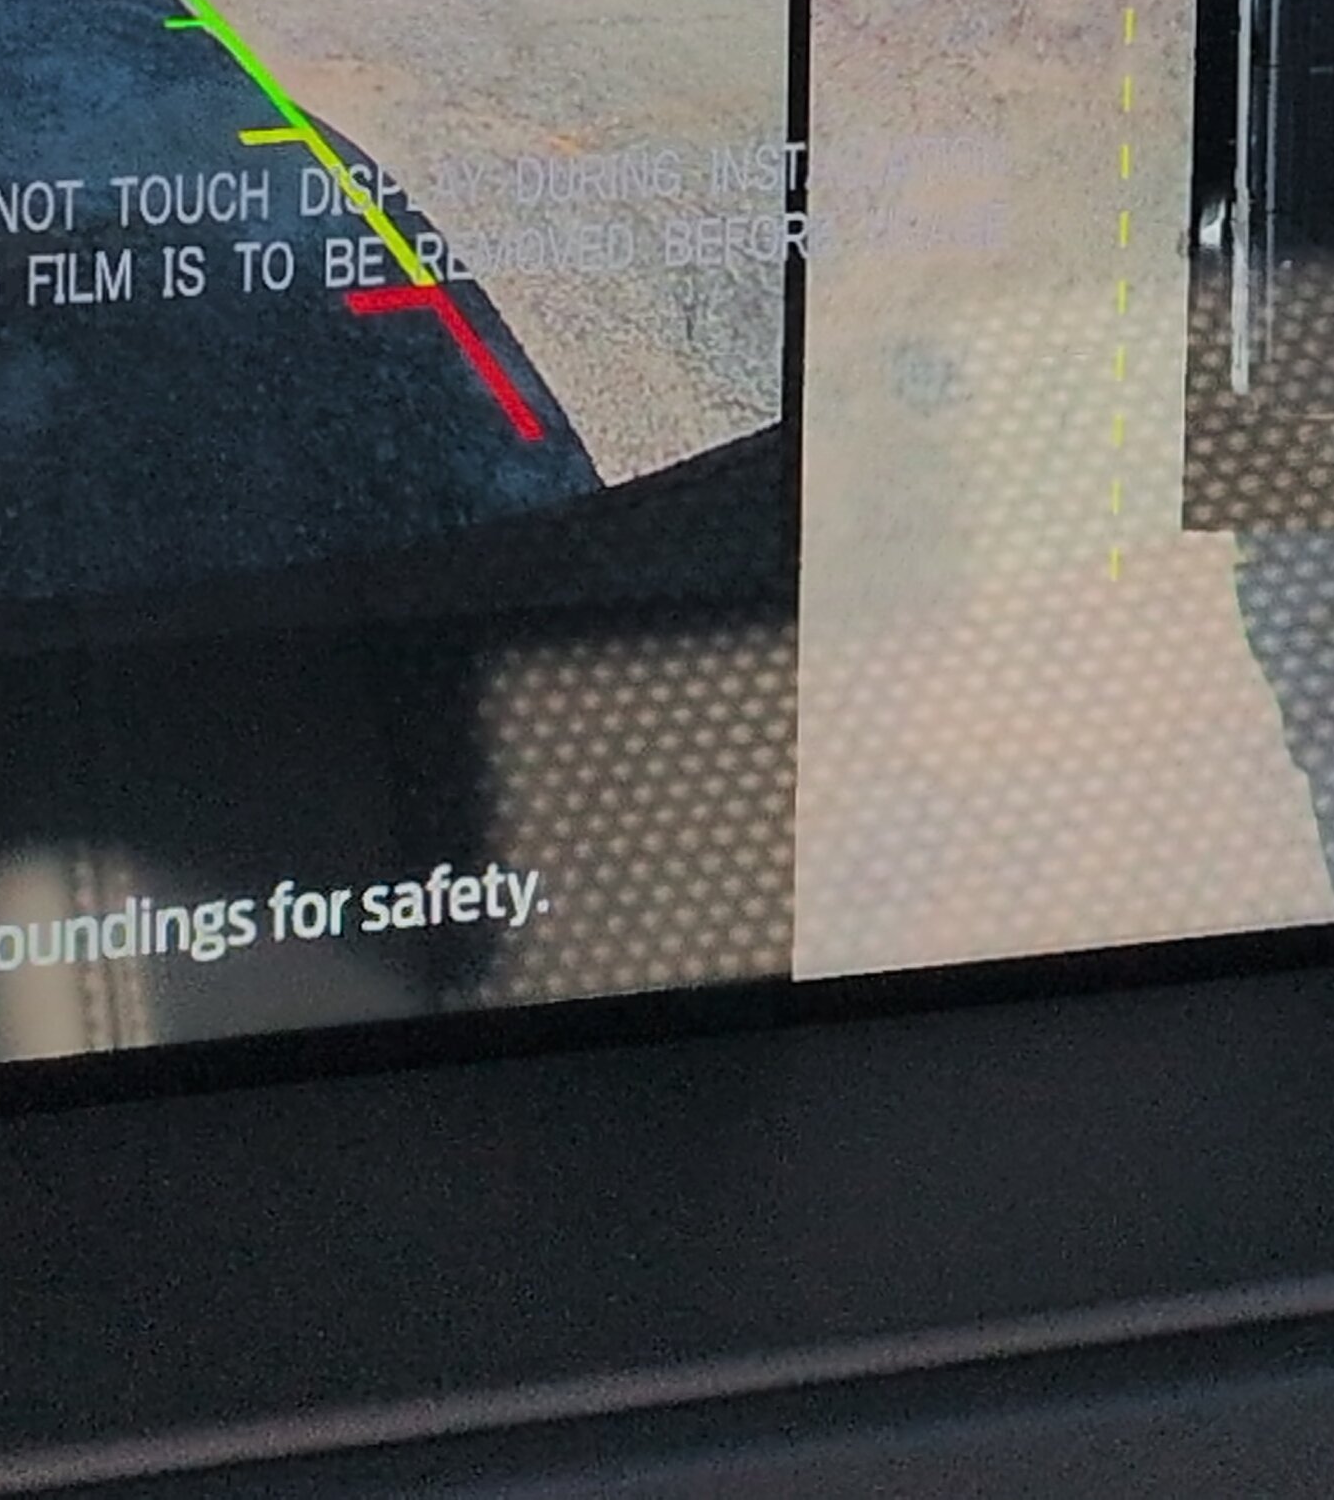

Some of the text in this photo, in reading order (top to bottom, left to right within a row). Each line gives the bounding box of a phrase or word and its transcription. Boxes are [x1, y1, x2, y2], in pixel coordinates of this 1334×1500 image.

[110, 169, 269, 228] TOUCH
[515, 150, 682, 202] DURING
[27, 248, 132, 306] FILM
[162, 246, 206, 298] IS
[234, 240, 295, 294] TO
[324, 237, 386, 288] BE
[268, 880, 351, 941] for
[361, 862, 550, 932] safety.
